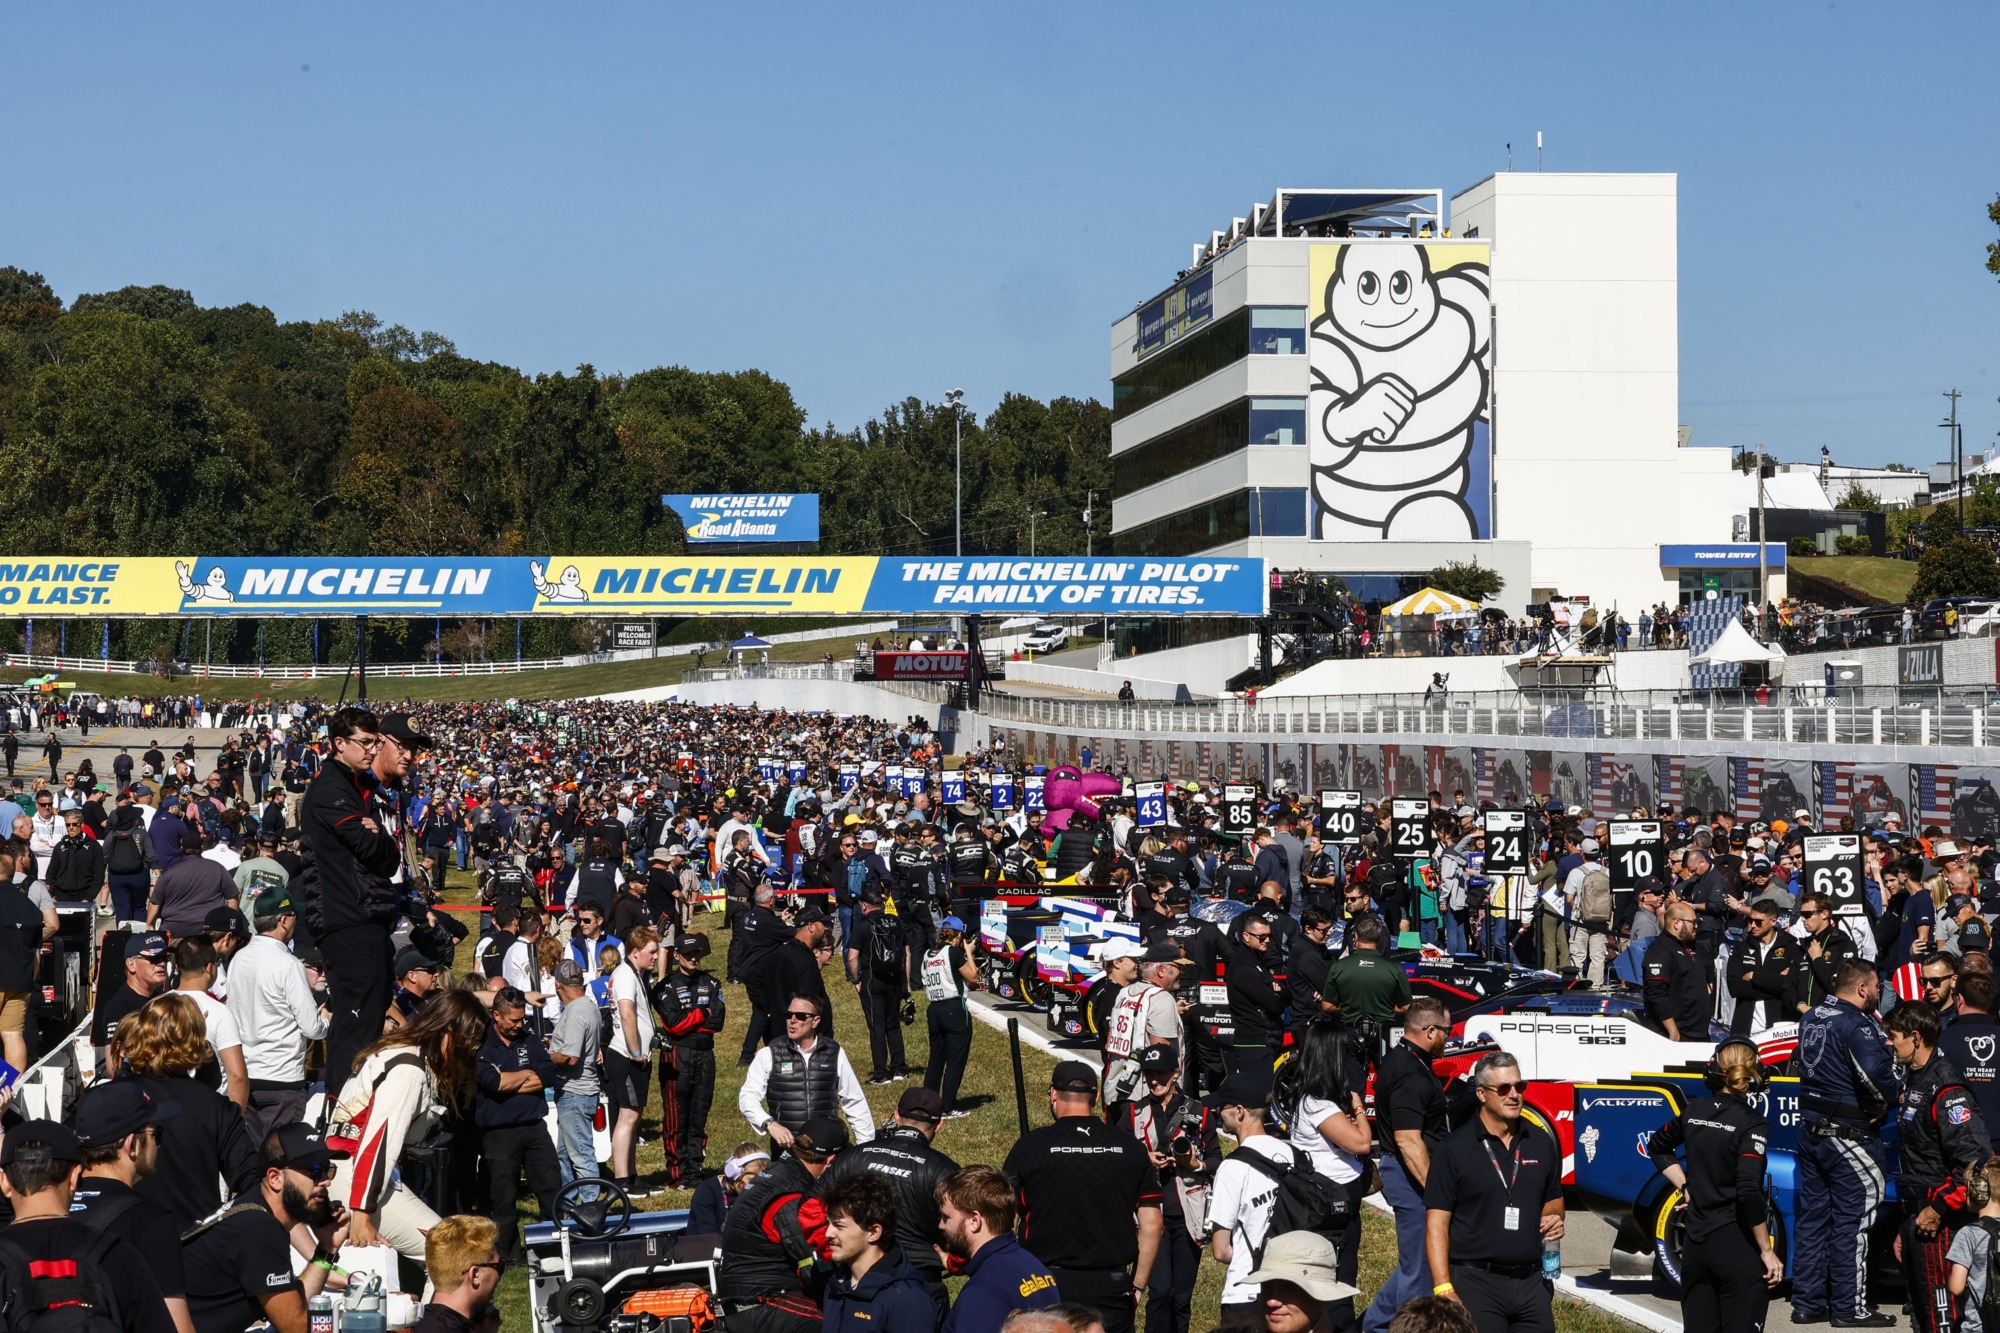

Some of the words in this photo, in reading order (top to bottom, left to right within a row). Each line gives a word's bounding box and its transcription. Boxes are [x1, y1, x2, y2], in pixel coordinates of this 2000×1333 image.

[690, 496, 793, 508] MICHELIN
[723, 509, 787, 517] RACEWAY
[700, 519, 730, 537] Road
[730, 519, 777, 537] Atlanta
[0, 564, 120, 582] MANCE
[902, 563, 960, 582] THE
[239, 568, 491, 595] MICHELIN
[593, 568, 842, 594] MICHELIN
[27, 586, 111, 605] LAST.
[933, 585, 1057, 604] FAMILY
[1060, 585, 1107, 604] OF
[1110, 586, 1205, 604] TIRES.
[894, 656, 965, 671] MOTUL
[760, 767, 771, 777] 11
[843, 775, 857, 787] 73
[907, 781, 921, 794] 18
[945, 784, 962, 798] 74
[998, 788, 1007, 803] 2
[1028, 791, 1044, 807] 22
[1140, 800, 1163, 818] 43
[1229, 805, 1252, 824] 85
[1326, 812, 1355, 834] 40
[1398, 823, 1425, 846] 25
[1491, 837, 1522, 861] 24
[1620, 850, 1653, 877] 10
[1813, 867, 1855, 898] 63
[926, 972, 941, 987] 300
[929, 988, 945, 1000] VIDEO
[1200, 1016, 1232, 1024] Fastron
[1500, 1023, 1626, 1035] PORSCHE
[1773, 1030, 1793, 1039] Mobil
[1108, 1036, 1130, 1053] PHTO
[1578, 1036, 1626, 1045] 963
[1582, 1098, 1664, 1111] VALKYRIE
[1687, 1118, 1736, 1132] PORSCHE
[1779, 1113, 1801, 1126] OF
[863, 1147, 926, 1165] PORSCHE
[1050, 1145, 1123, 1154] PORSCHE
[867, 1162, 912, 1178] PENSKE
[266, 1270, 291, 1287] SUMMI
[1019, 1273, 1057, 1298] dallara
[311, 1315, 332, 1324] LIQU
[311, 1324, 333, 1333] MOLY
